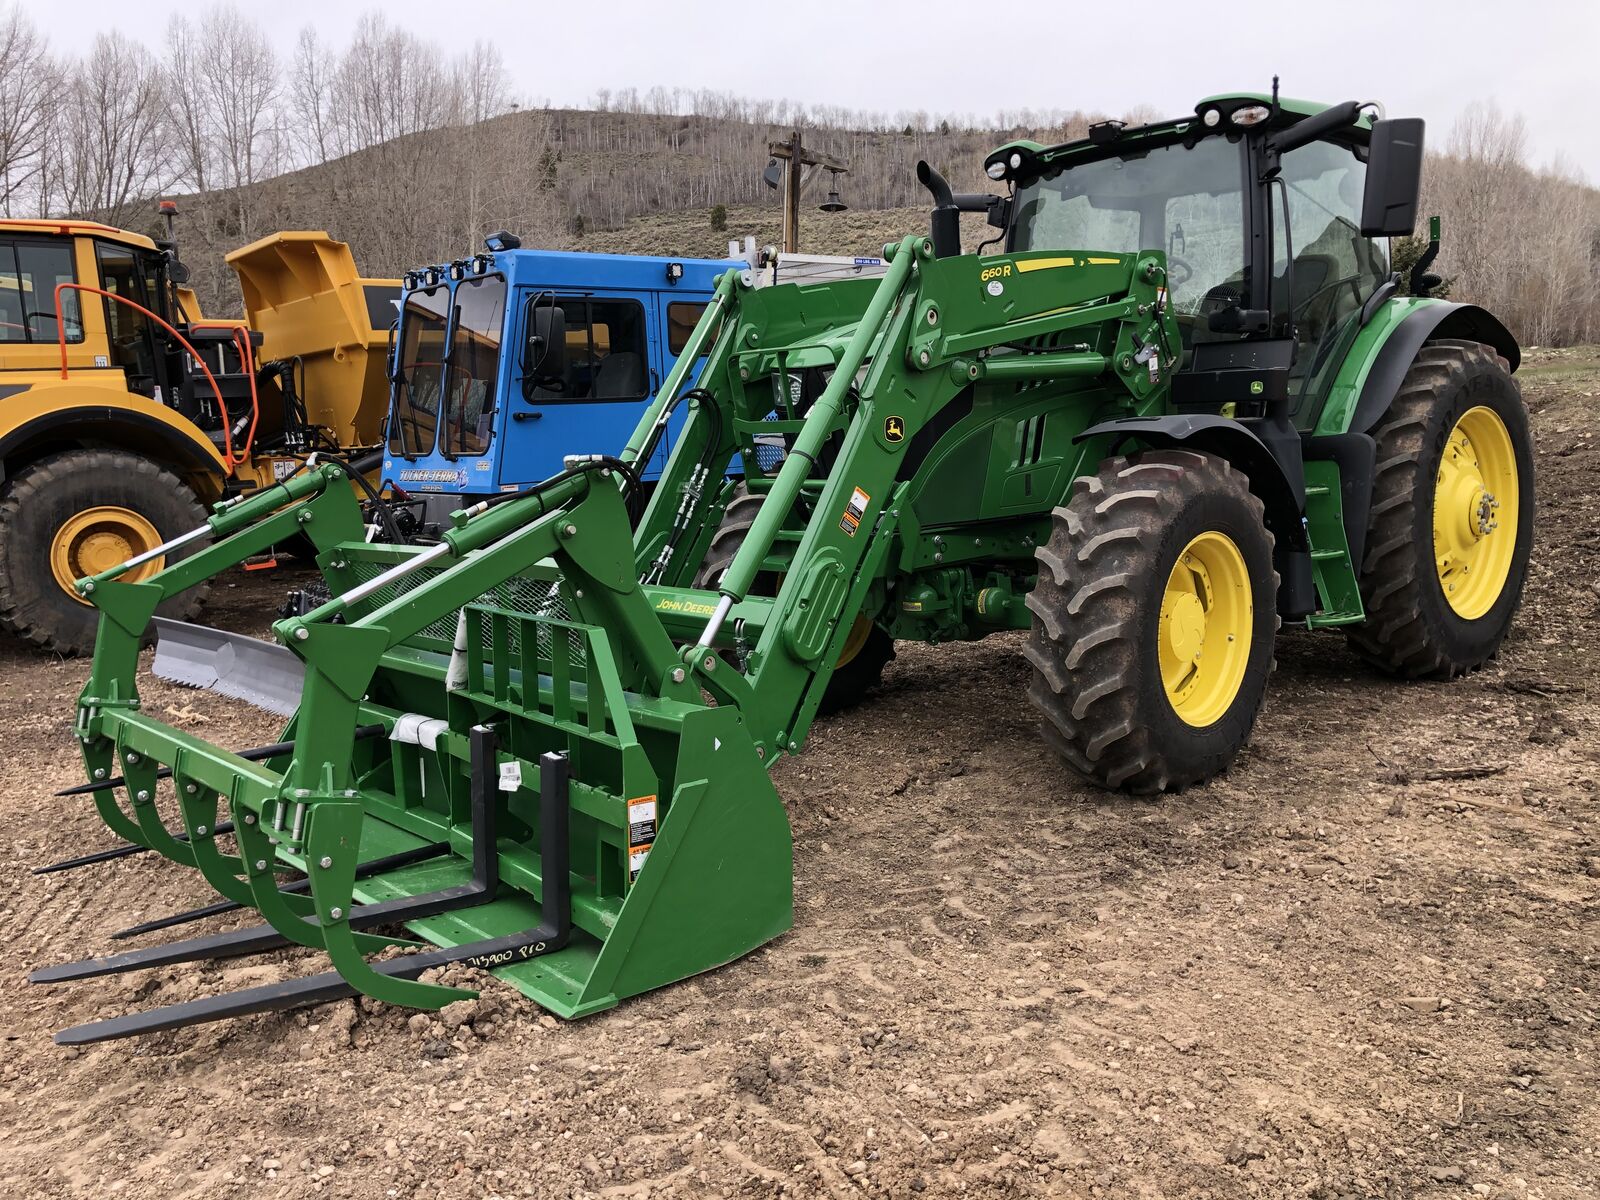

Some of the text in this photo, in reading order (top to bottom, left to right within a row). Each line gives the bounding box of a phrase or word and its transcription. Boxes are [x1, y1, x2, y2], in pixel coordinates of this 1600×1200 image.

[981, 265, 1011, 281] 660 R
[400, 469, 458, 483] TUCKER-TERRA
[656, 599, 717, 615] JOHN DEERE
